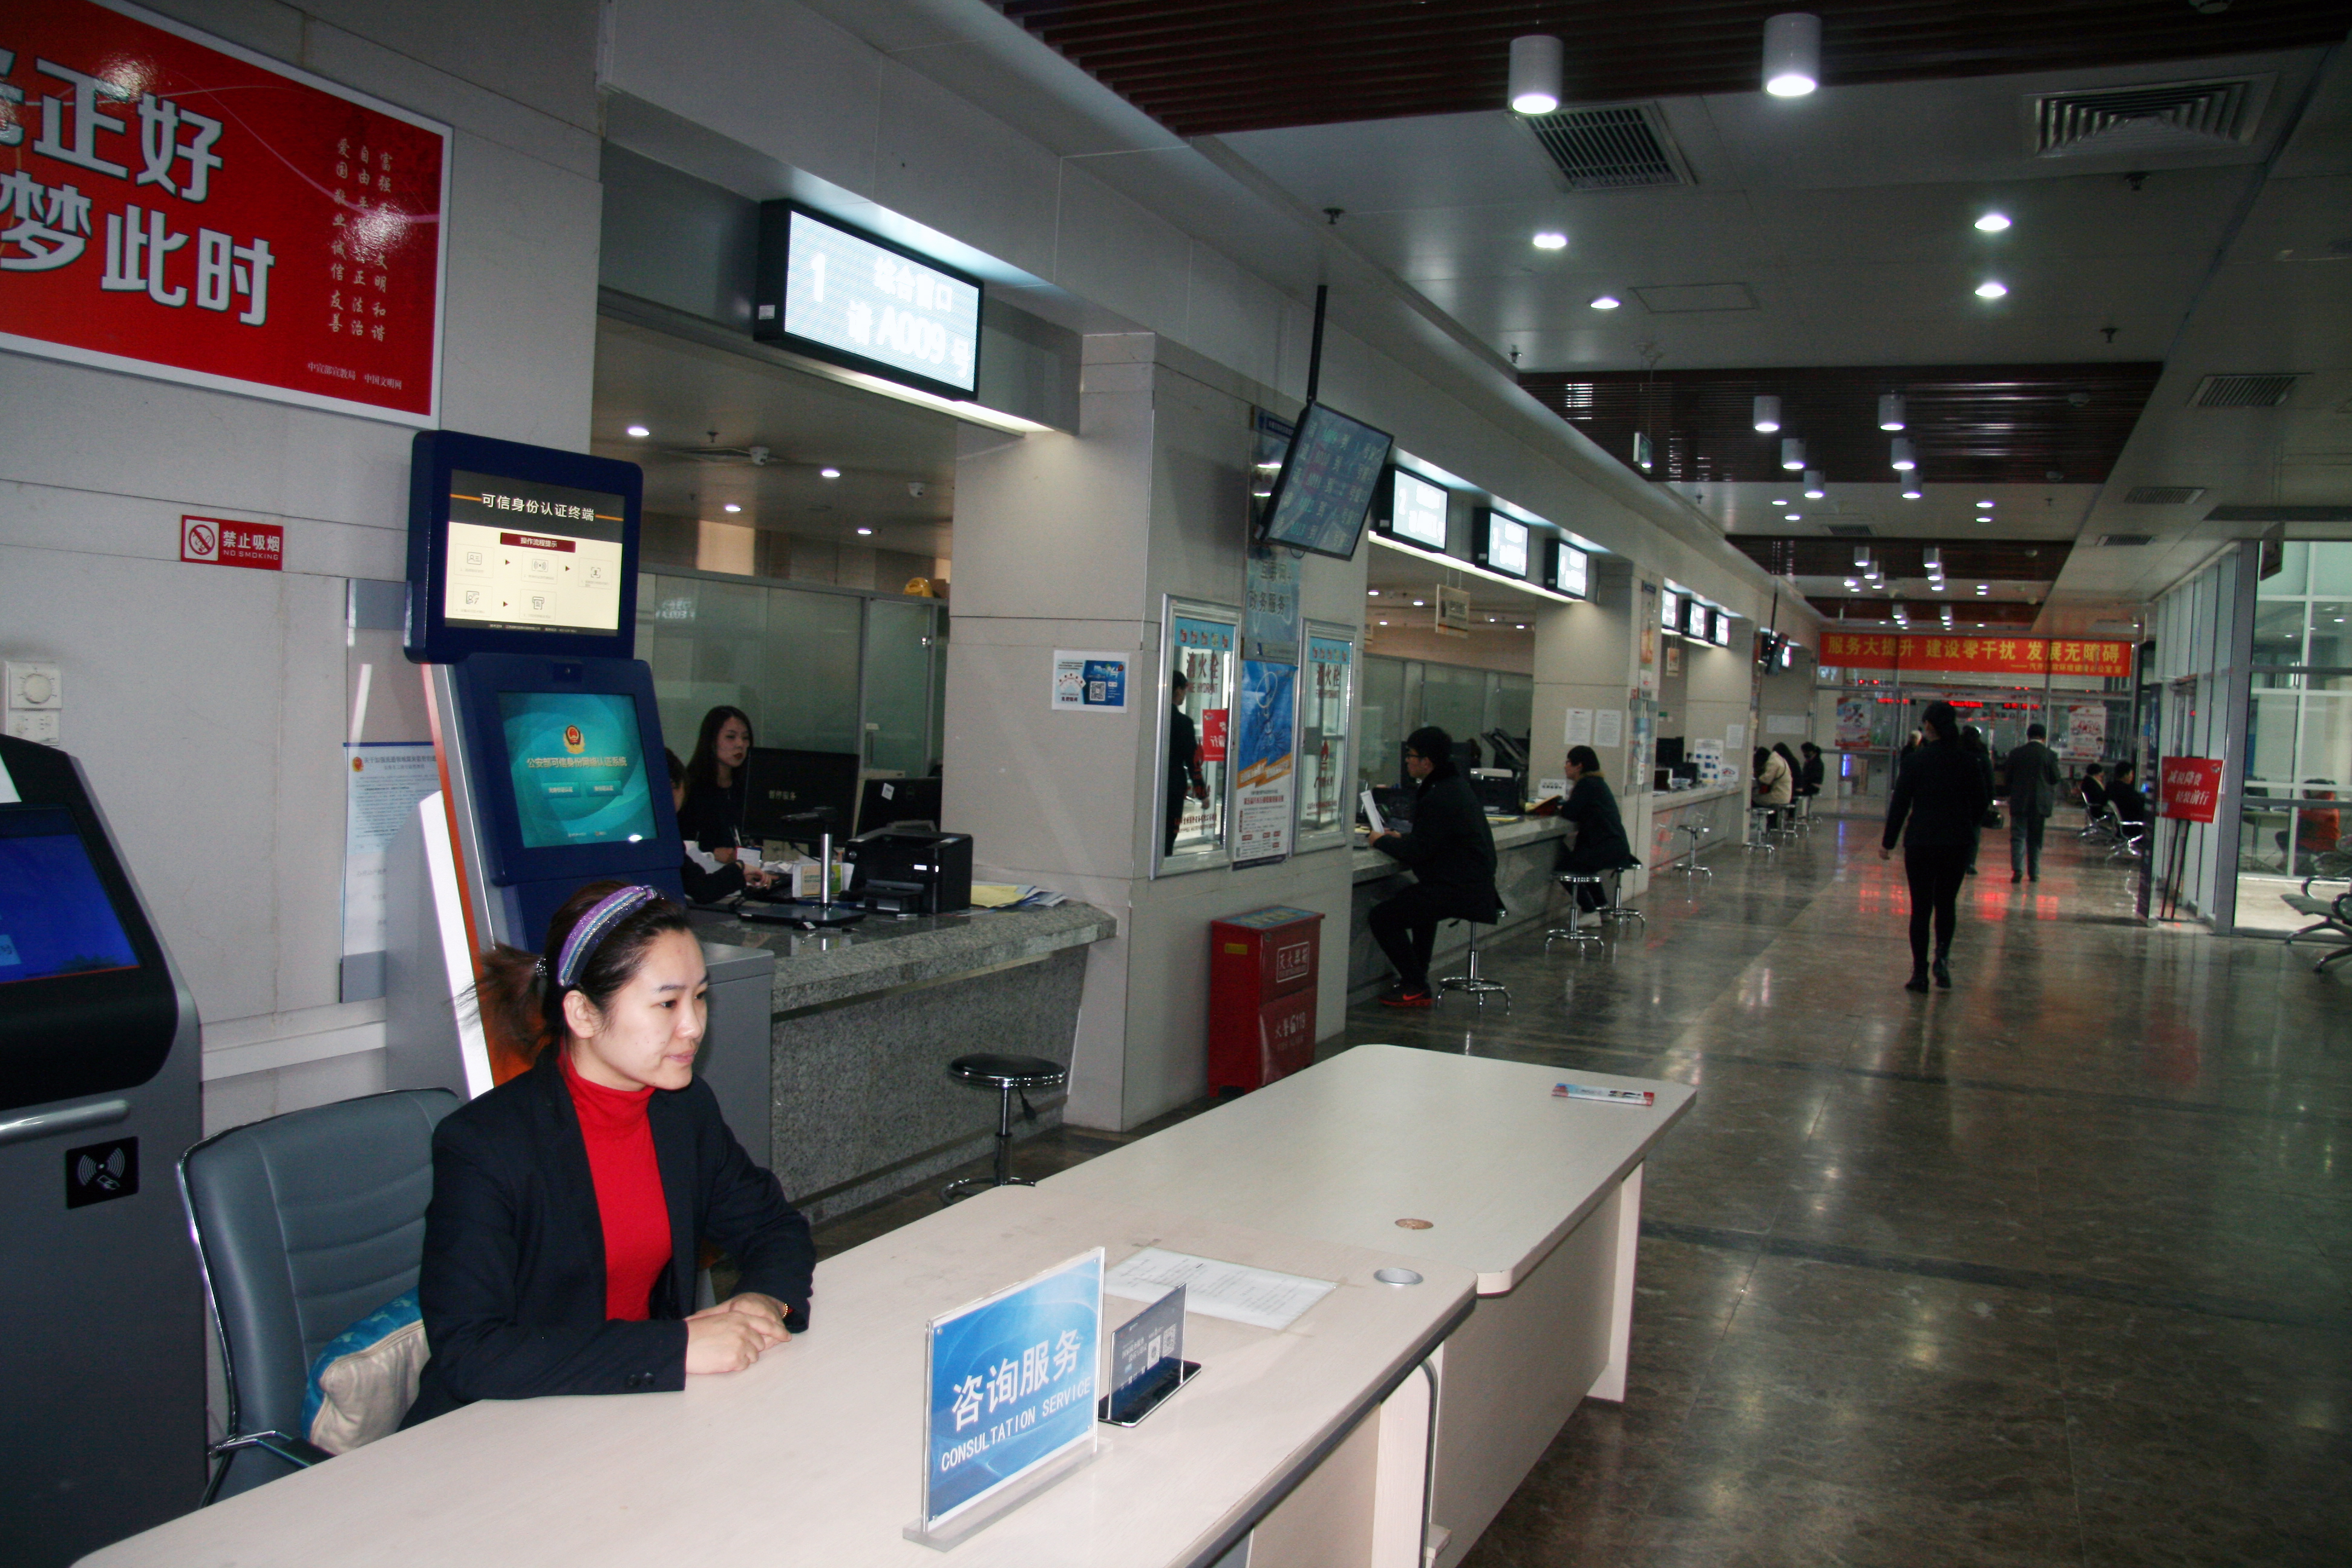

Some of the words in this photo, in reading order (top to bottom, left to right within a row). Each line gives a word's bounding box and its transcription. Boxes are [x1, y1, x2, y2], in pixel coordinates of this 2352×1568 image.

[0, 47, 223, 204] 正好
[811, 252, 826, 302] 1
[482, 492, 595, 522] 可信身份认证终端
[1398, 488, 1407, 515] 2
[223, 530, 281, 552] 禁止吸烟
[520, 536, 557, 548] 操作流程提示
[238, 550, 279, 561] SMOKING
[1186, 648, 1220, 679] 消火栓
[1828, 636, 1915, 657] 服务大提升
[1926, 639, 2016, 660] 建设零干扰
[2027, 640, 2120, 664] 发展无障碍
[1316, 662, 1341, 687] 消火栓
[2175, 789, 2210, 806] 轻装前行
[951, 1328, 1083, 1432] 咨询服务
[941, 1407, 1036, 1471] CONSULTATION
[1042, 1377, 1092, 1417] SERVICE
